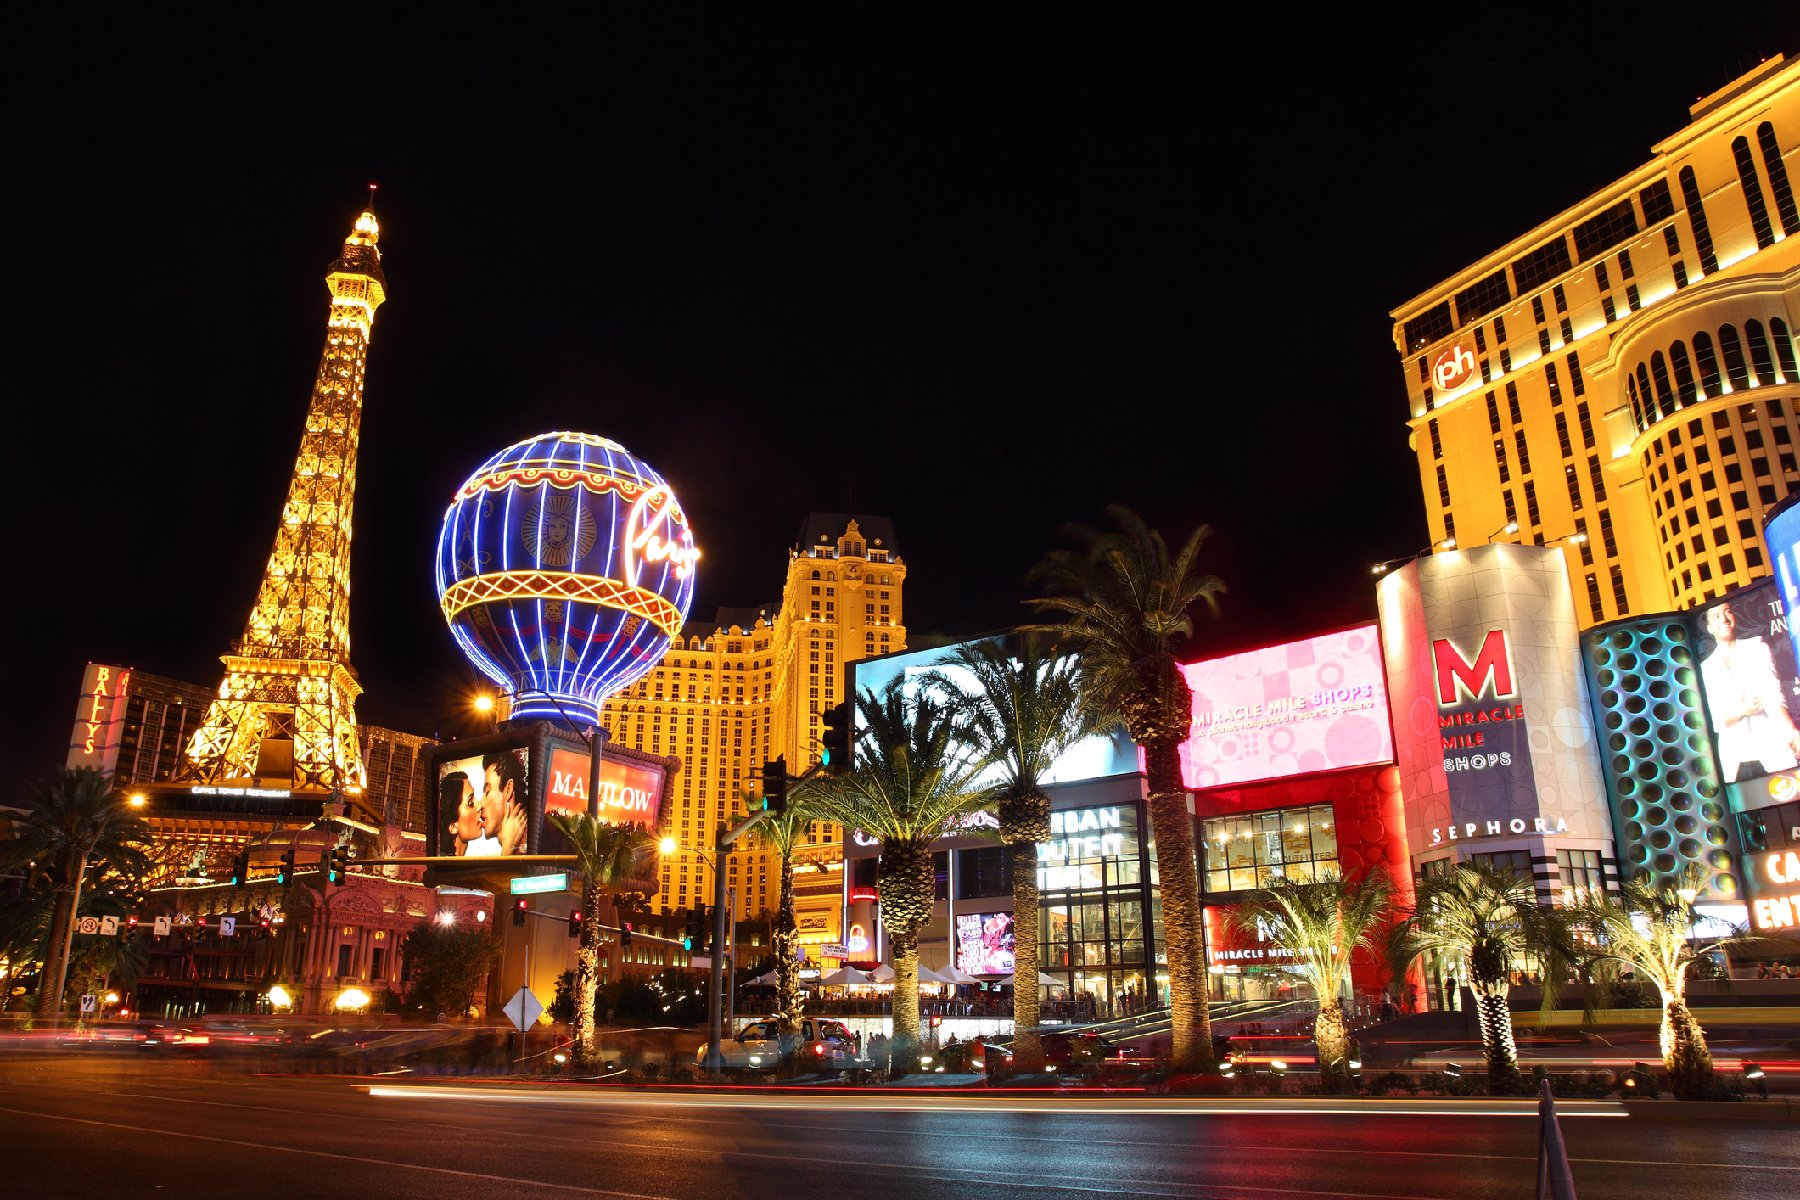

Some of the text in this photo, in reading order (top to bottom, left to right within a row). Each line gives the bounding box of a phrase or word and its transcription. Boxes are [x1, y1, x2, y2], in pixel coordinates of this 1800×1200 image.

[1437, 345, 1475, 388] ph
[1432, 629, 1513, 705] M
[1193, 684, 1372, 728] MIRACLE MILE SHOPS
[1438, 704, 1525, 729] MIRACLE
[1242, 714, 1289, 730] hollywood
[1441, 731, 1484, 750] MILE
[1443, 752, 1512, 772] SHOPS
[552, 770, 653, 812] MAILOW
[1051, 807, 1120, 834] RBAN
[1433, 817, 1569, 843] SEPHORA
[1214, 949, 1264, 960] MIRACLE
[1268, 948, 1294, 957] MILE
